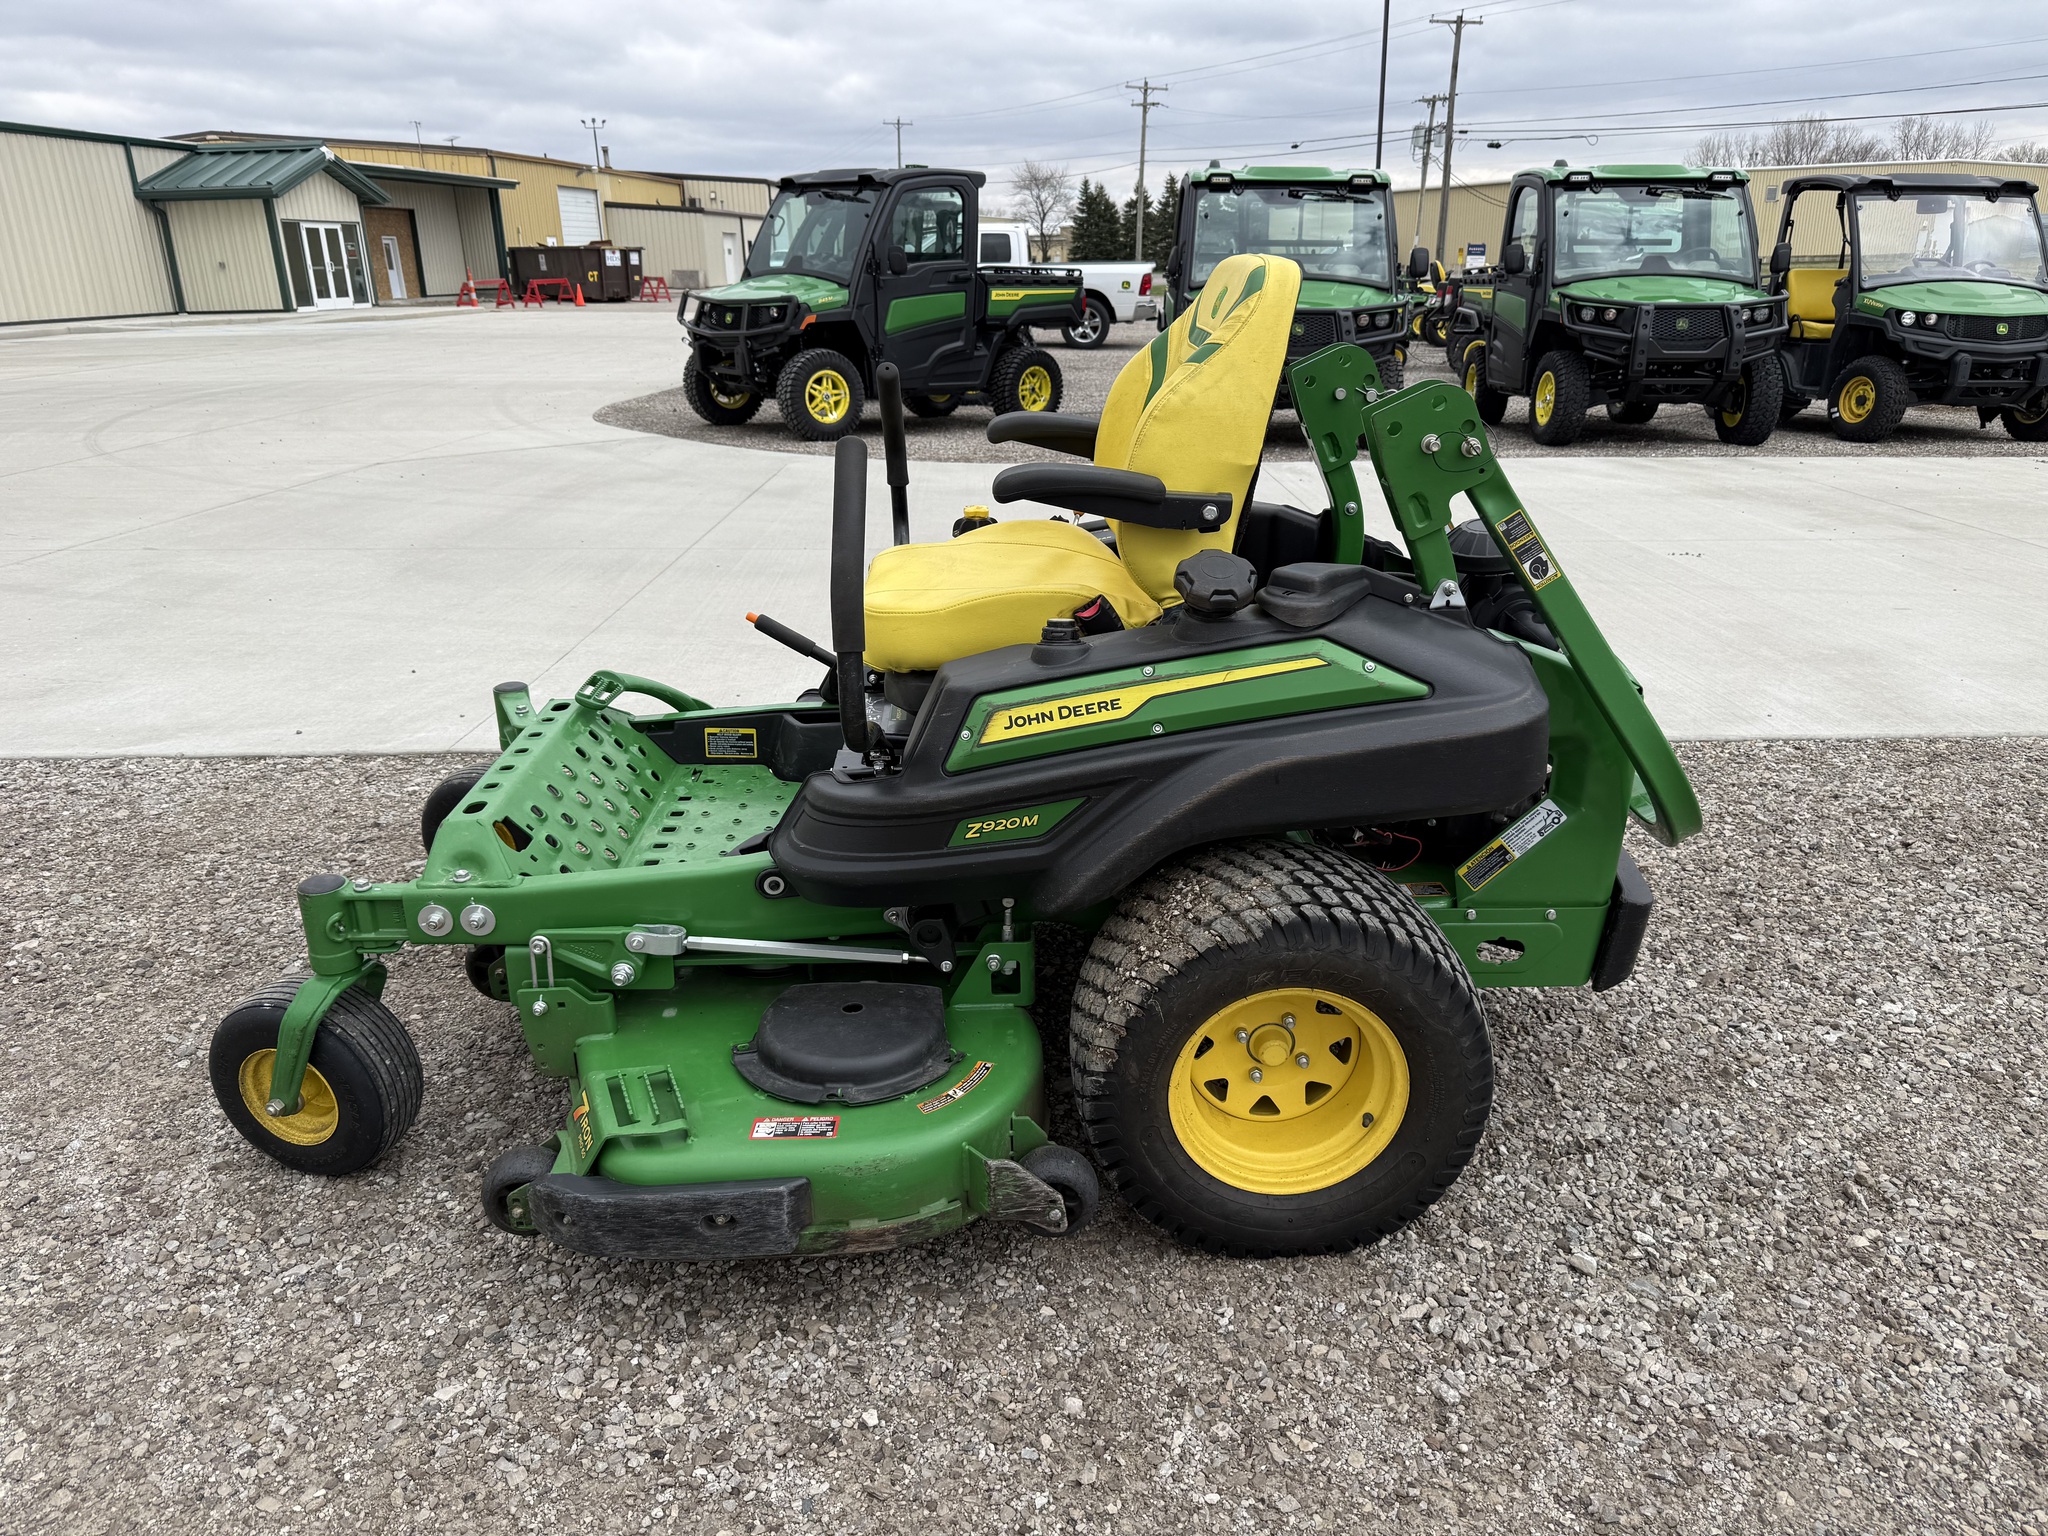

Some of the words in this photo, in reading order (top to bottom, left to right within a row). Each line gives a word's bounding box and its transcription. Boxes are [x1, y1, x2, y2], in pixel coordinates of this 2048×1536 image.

[588, 271, 598, 282] CT
[1003, 710, 1055, 731] JOHN
[1057, 698, 1123, 721] DEERE
[965, 814, 1040, 839] Z920M
[1244, 967, 1390, 1003] KENDA
